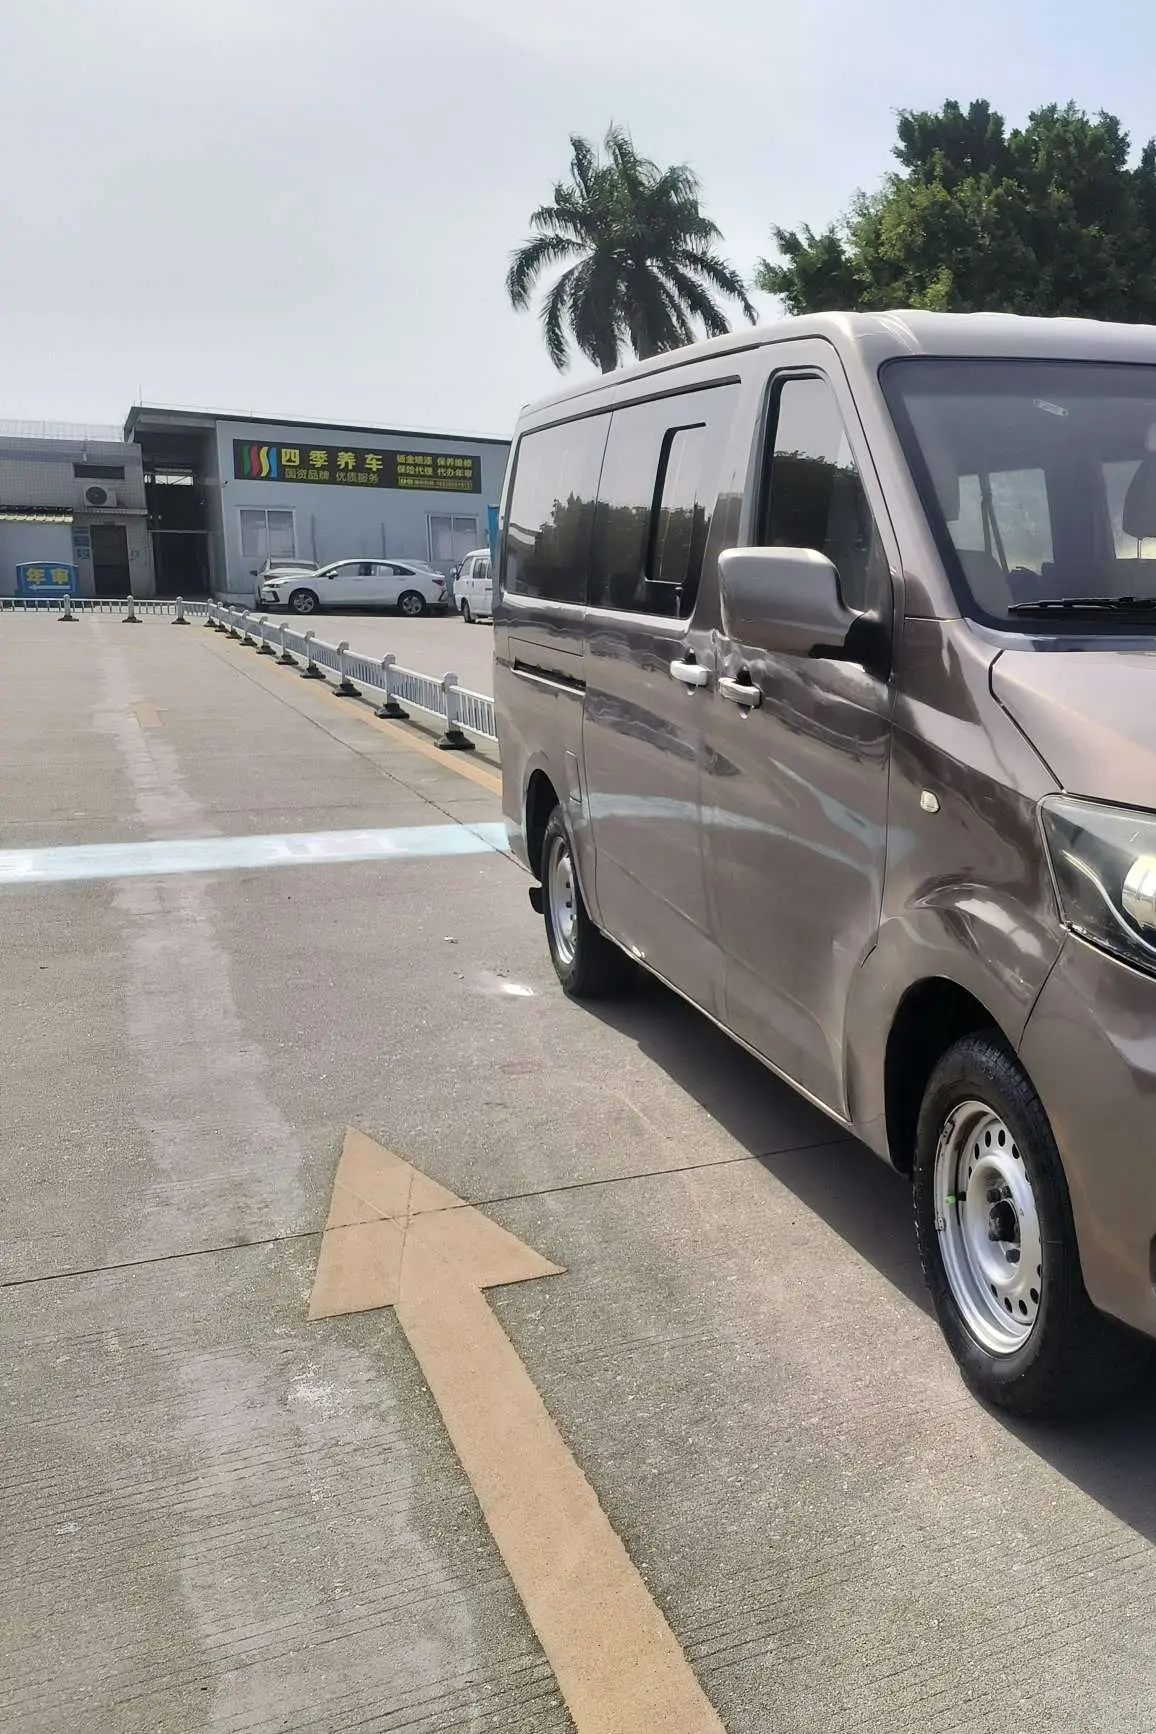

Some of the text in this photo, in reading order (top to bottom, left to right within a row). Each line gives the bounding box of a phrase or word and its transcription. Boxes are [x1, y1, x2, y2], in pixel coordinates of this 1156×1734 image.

[281, 448, 383, 471] 四季养车
[336, 471, 380, 485] 优质服务
